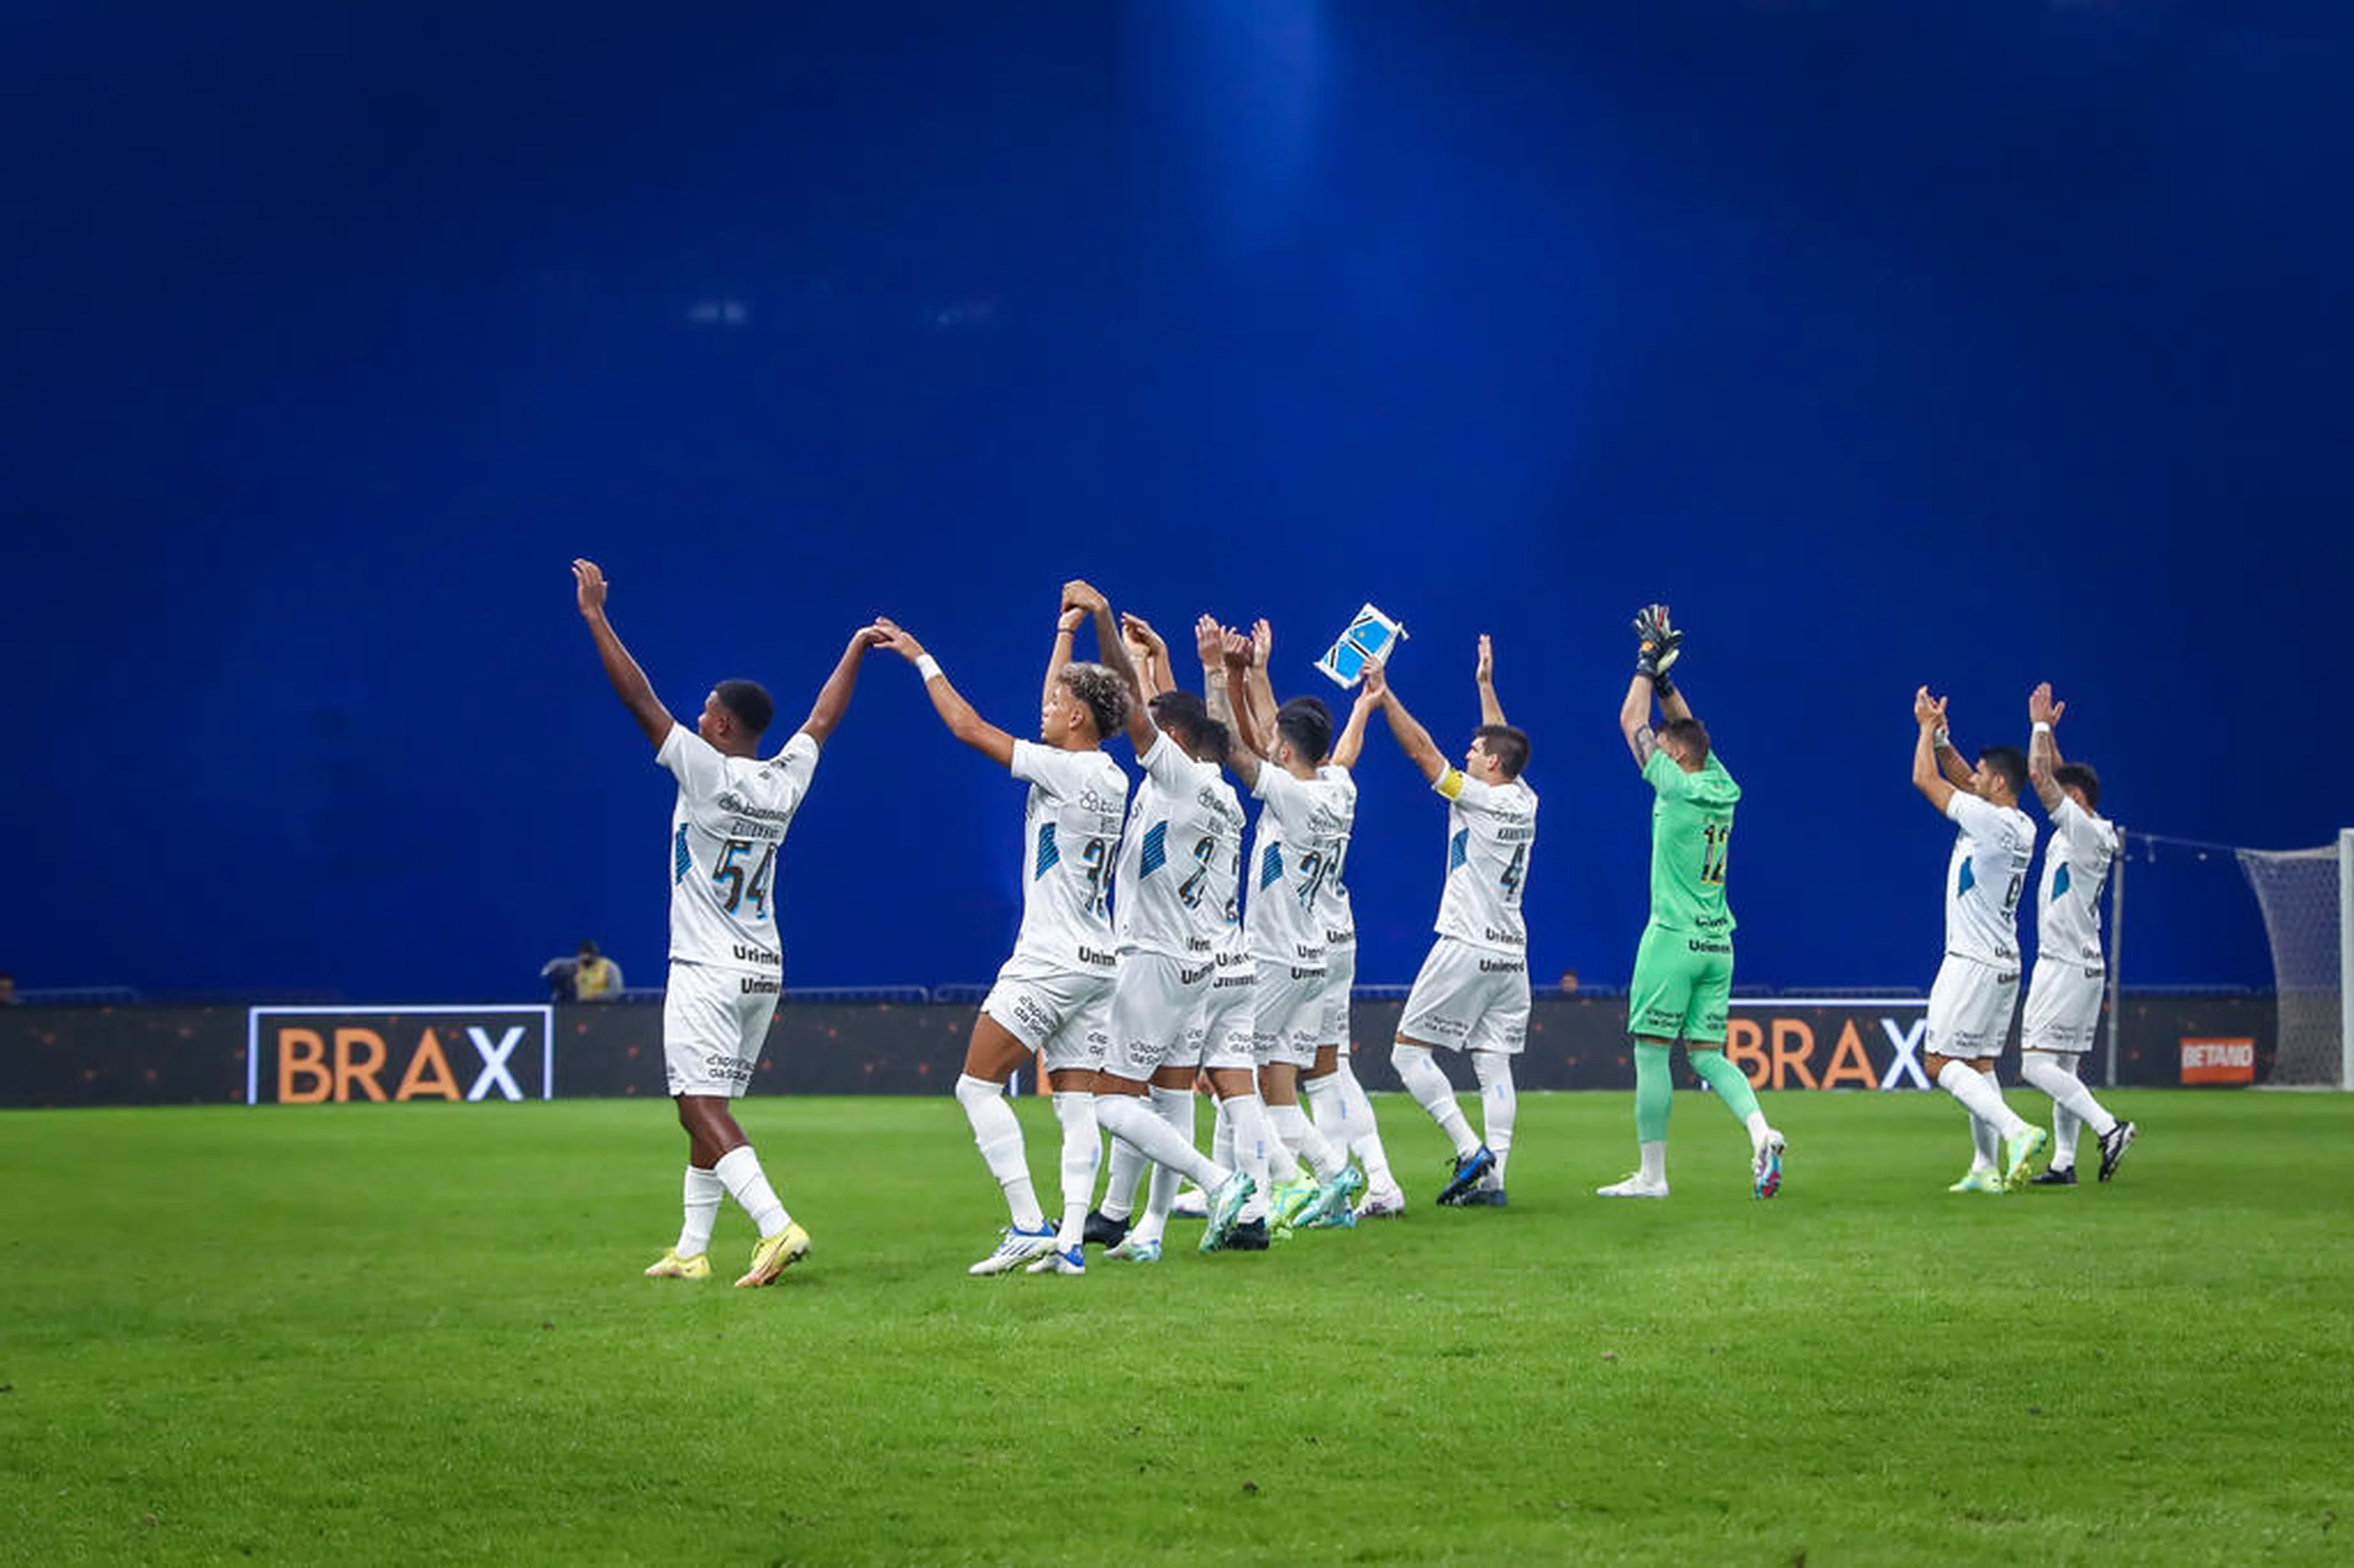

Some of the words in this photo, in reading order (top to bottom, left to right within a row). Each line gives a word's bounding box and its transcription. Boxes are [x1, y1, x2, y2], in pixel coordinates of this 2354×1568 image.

[712, 839, 777, 919] 54
[1498, 842, 1525, 902] 4
[278, 1026, 527, 1103] BRAX
[1726, 1017, 1931, 1090] BRAX
[2182, 1044, 2253, 1067] BETANO
